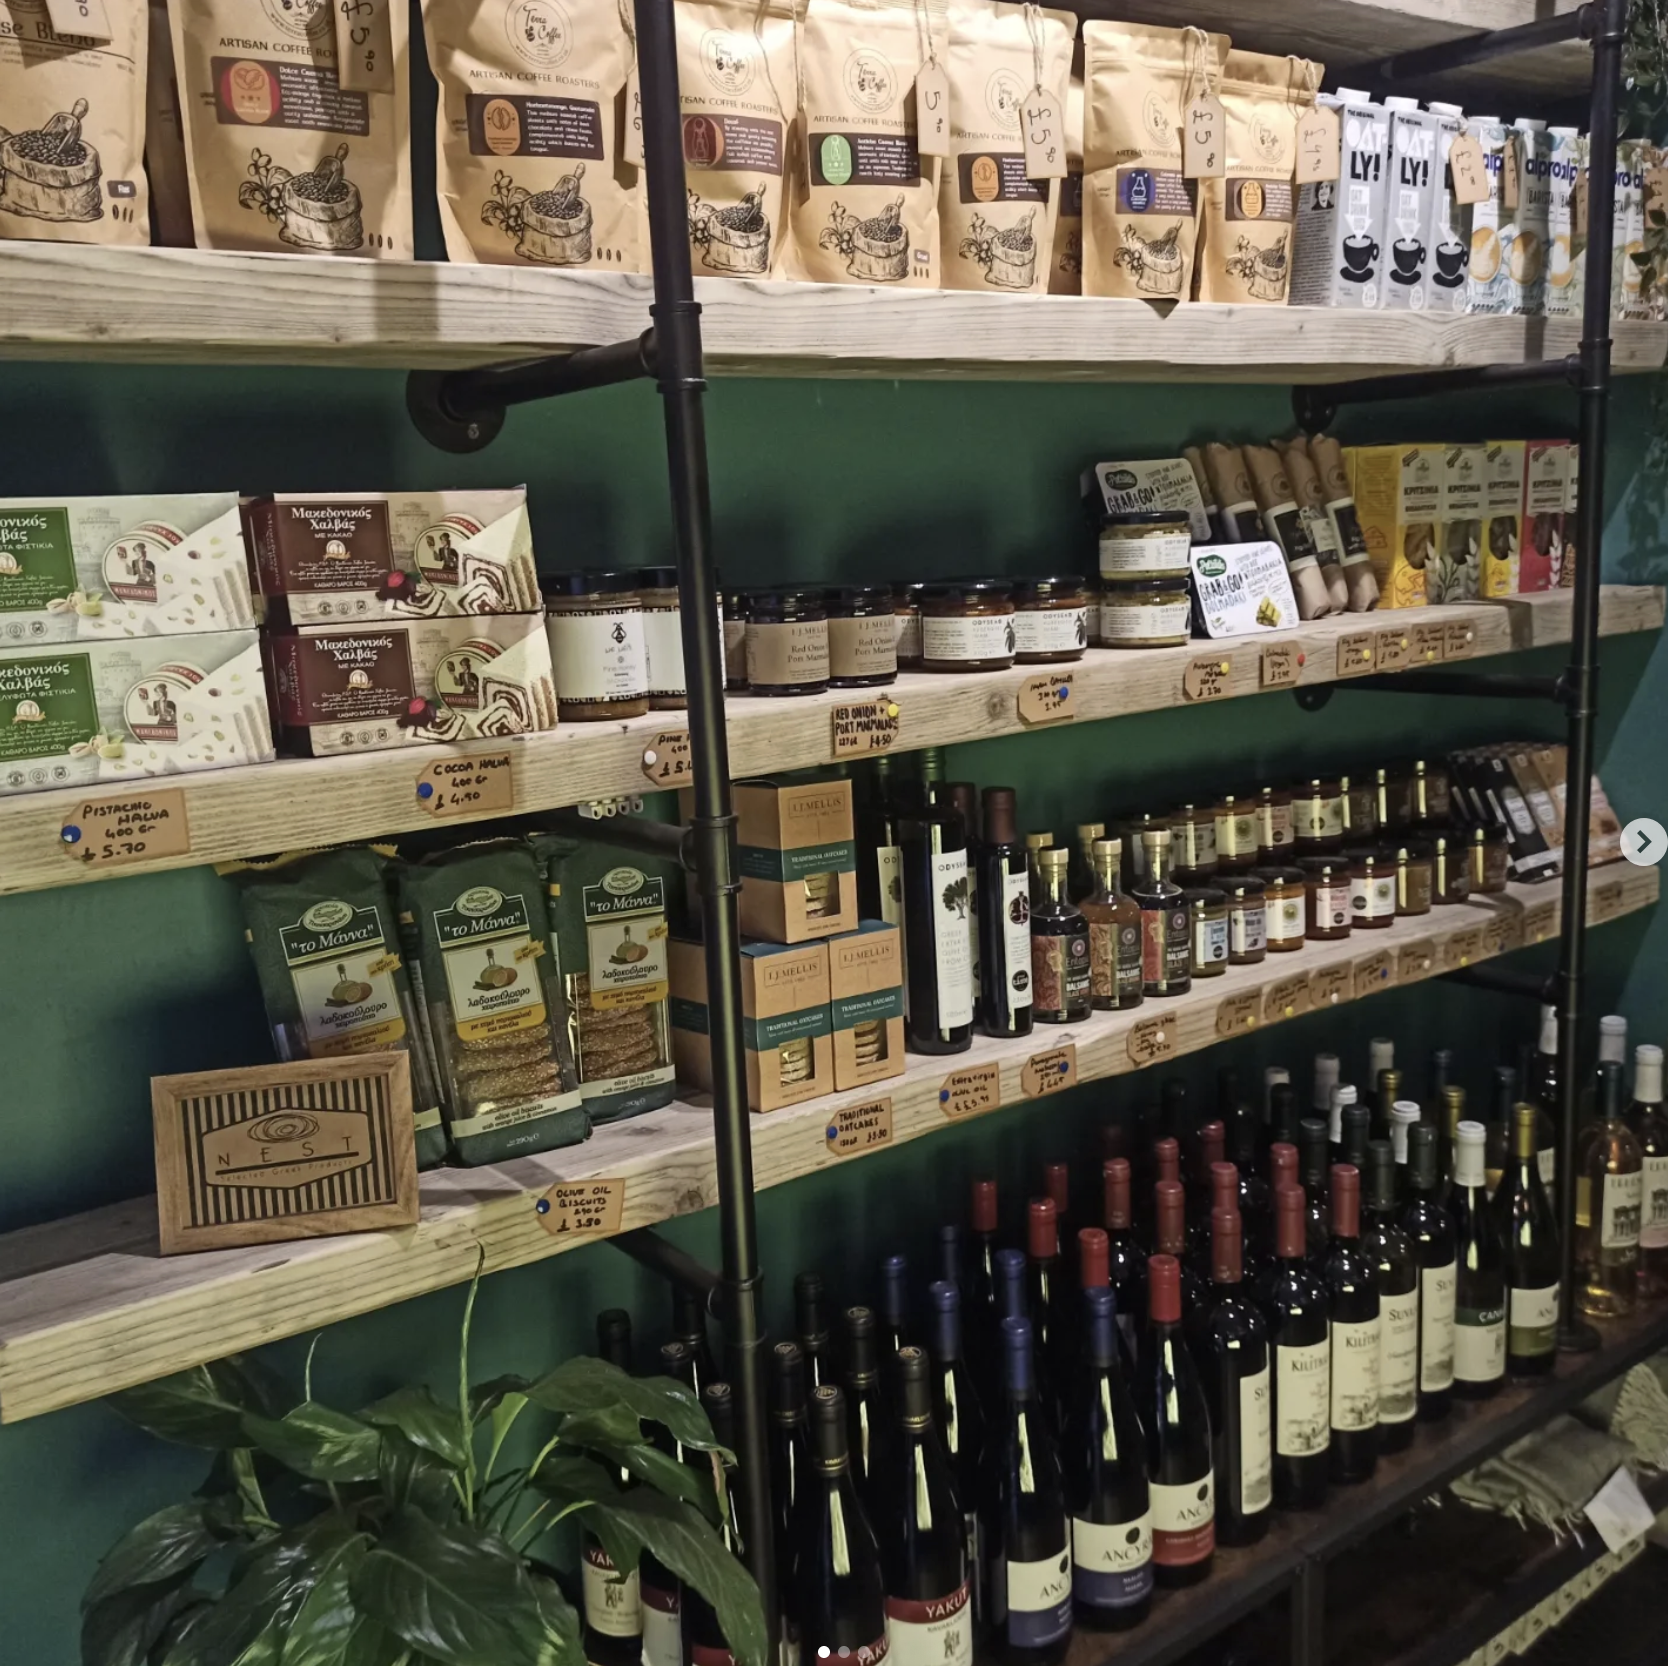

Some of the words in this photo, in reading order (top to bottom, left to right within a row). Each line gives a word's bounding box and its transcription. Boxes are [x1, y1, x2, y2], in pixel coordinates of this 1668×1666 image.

[219, 37, 268, 51] ARTISAN
[273, 43, 312, 56] COFFEE
[470, 69, 513, 80] ARTISAN
[517, 71, 552, 83] COFFEE
[555, 75, 600, 90] ROASTERS
[709, 97, 738, 109] COFFEE
[813, 115, 848, 124] ARTISAN
[852, 117, 879, 126] COFFEE
[1347, 109, 1356, 117] THE
[1356, 110, 1375, 119] ORIGINAL
[1397, 116, 1405, 124] THE
[956, 131, 990, 140] ARTISAN
[1350, 150, 1380, 182] LY!
[1400, 156, 1428, 188] LY!
[1525, 154, 1561, 181] alpro
[1528, 188, 1554, 205] BARISTA
[291, 506, 372, 520] Μακεδονικός
[309, 518, 356, 532] Χαλβάς
[314, 636, 393, 651] Μακεδονικός
[791, 645, 806, 653] Red
[858, 638, 873, 646] Red
[333, 648, 378, 662] Χαλβάς
[855, 647, 871, 656] Port
[836, 707, 850, 721] RED
[851, 704, 877, 719] ONION
[835, 720, 854, 735] PORT
[658, 734, 681, 746] PINE
[433, 762, 473, 776] COCOA
[479, 756, 510, 771] HALVA
[451, 776, 474, 789] 400
[435, 794, 445, 811] £
[451, 791, 481, 805] 4.90
[83, 800, 153, 819] PISTACHIO
[118, 808, 170, 826] HALVA
[105, 827, 134, 840] 400
[138, 824, 156, 835] Gr
[101, 840, 147, 860] 5.70
[791, 853, 823, 863] TRADITIONAL
[823, 849, 848, 858] OATCAKES
[841, 1001, 872, 1012] TRADITIONAL
[873, 995, 896, 1006] OATCAKES
[766, 1019, 799, 1032] TRADITIONAL
[799, 1013, 824, 1024] OATCAKES
[494, 1112, 510, 1121] olive
[510, 1109, 520, 1117] oil
[521, 1103, 544, 1113] biscuits
[838, 1104, 884, 1123] TRADITIONAL
[838, 1117, 878, 1132] OATCAKES
[218, 1135, 353, 1167] NEST
[220, 1171, 265, 1182] Selected
[272, 1165, 302, 1175] Greek
[308, 1160, 353, 1170] Products
[556, 1188, 585, 1198] OLIVE
[592, 1186, 611, 1195] OIL
[559, 1197, 607, 1208] BISCUITS
[925, 1586, 968, 1619] YAKUT
